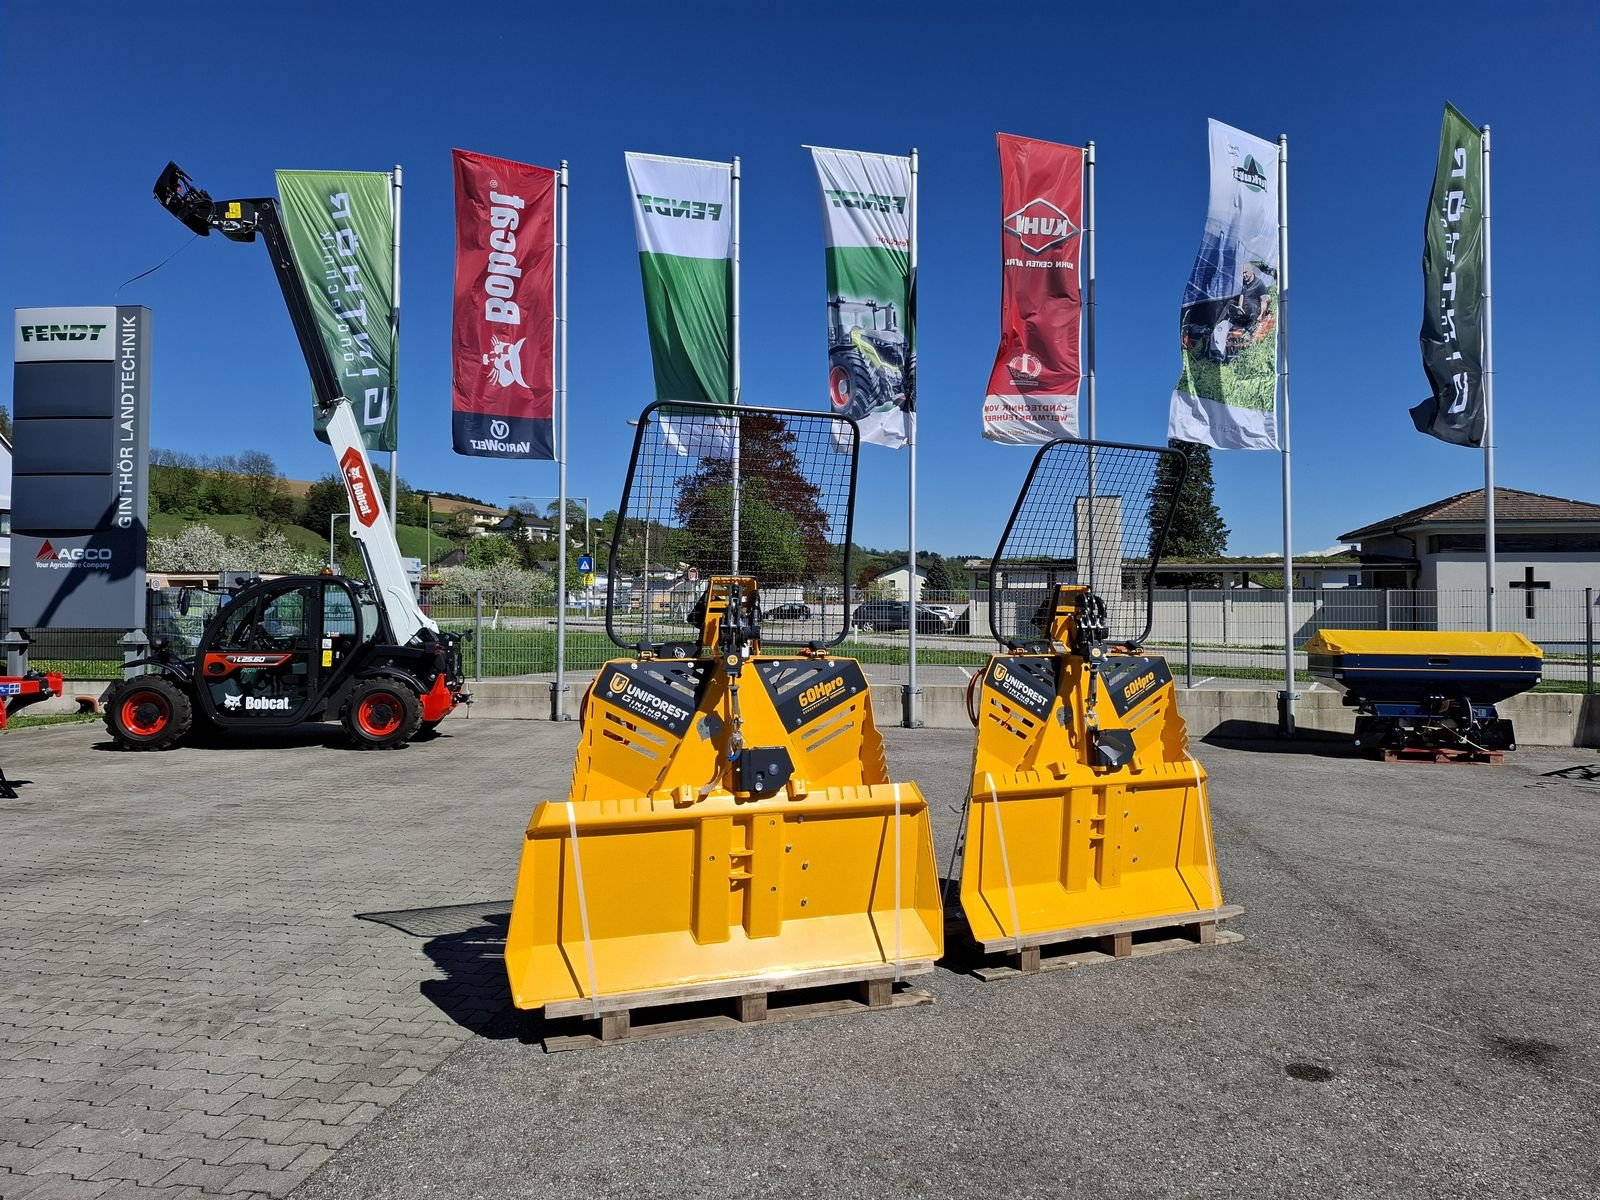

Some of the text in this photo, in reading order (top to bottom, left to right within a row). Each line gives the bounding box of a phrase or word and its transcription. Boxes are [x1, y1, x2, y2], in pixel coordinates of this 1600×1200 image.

[20, 324, 107, 343] FENDT
[116, 315, 137, 529] GINTHÖR LANDTECHNIK
[352, 482, 372, 517] Bobcat
[49, 561, 82, 570] Agriculture
[82, 561, 110, 570] Company
[58, 548, 113, 560] AGCO
[245, 696, 290, 710] Bobcat
[626, 684, 690, 721] UNIFOREST
[798, 676, 844, 707] 60Hpro
[1005, 673, 1048, 706] UNIFOREST
